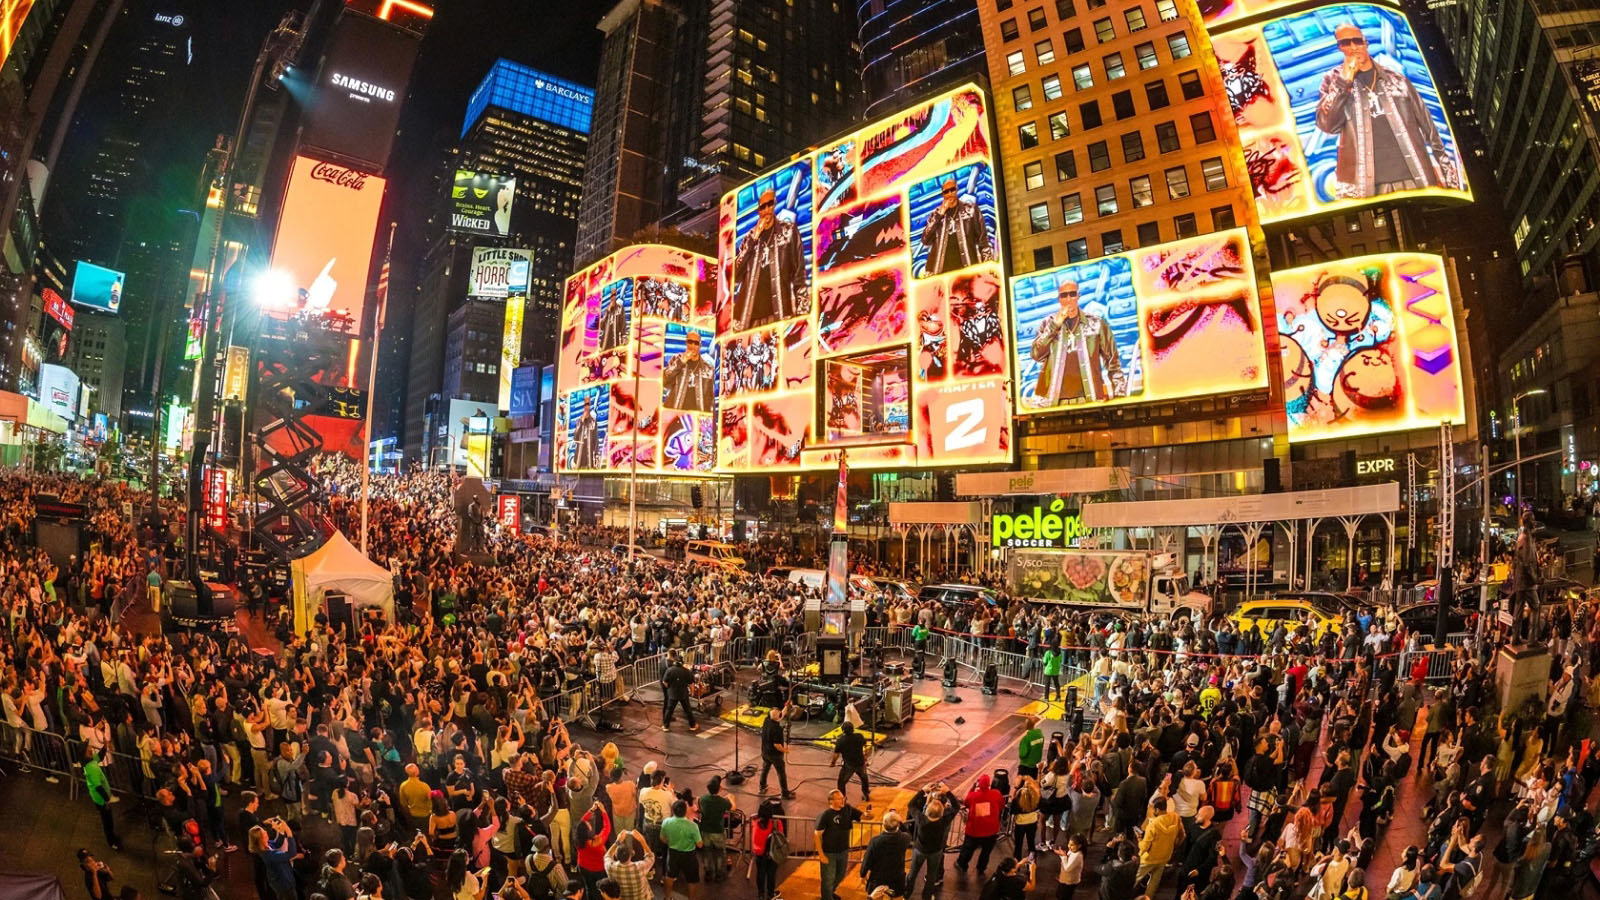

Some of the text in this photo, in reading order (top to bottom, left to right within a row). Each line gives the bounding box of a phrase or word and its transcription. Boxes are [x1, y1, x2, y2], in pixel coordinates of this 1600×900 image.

[331, 73, 395, 102] SAMSUNG
[545, 82, 590, 104] BARCLAYS
[311, 161, 366, 191] Coca-Cola
[479, 250, 507, 263] LITTLE
[944, 397, 988, 453] 2
[1356, 458, 1395, 475] EXPR
[1568, 435, 1576, 473] 1540
[1009, 471, 1034, 490] pelé
[504, 497, 517, 526] tkts
[992, 498, 1064, 547] pelé
[1007, 539, 1053, 547] SOCCER
[1204, 699, 1214, 709] 18
